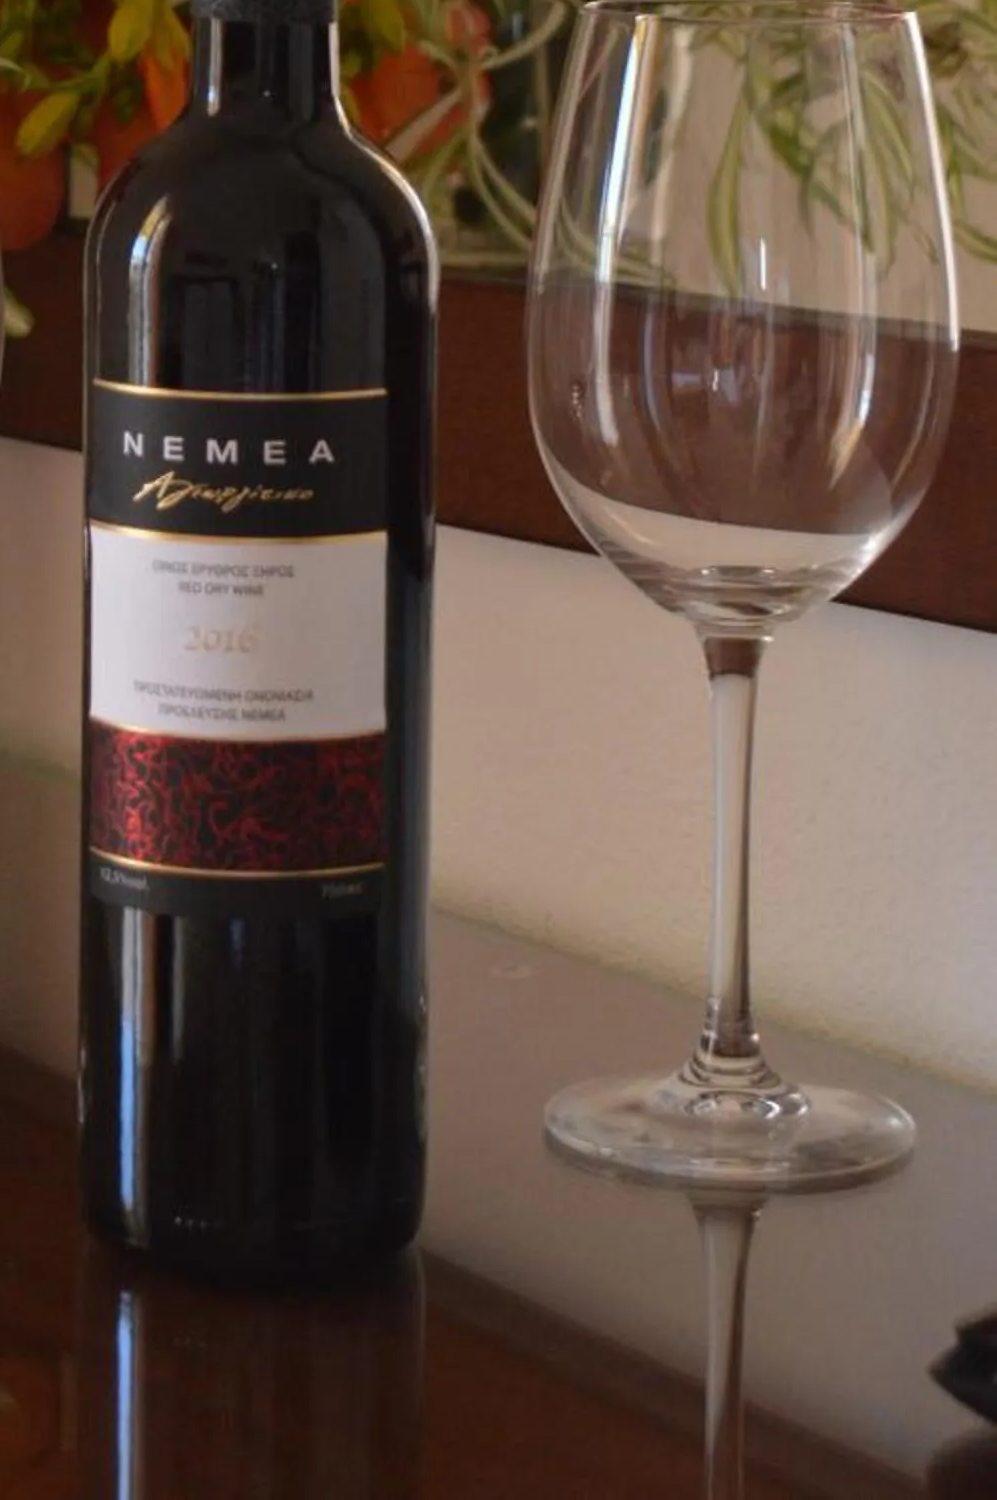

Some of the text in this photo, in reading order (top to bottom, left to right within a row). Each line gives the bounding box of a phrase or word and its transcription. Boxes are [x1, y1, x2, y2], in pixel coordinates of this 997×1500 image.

[122, 430, 335, 466] NEMEA
[178, 580, 264, 597] RED DRY WINE
[183, 622, 260, 654] 2016
